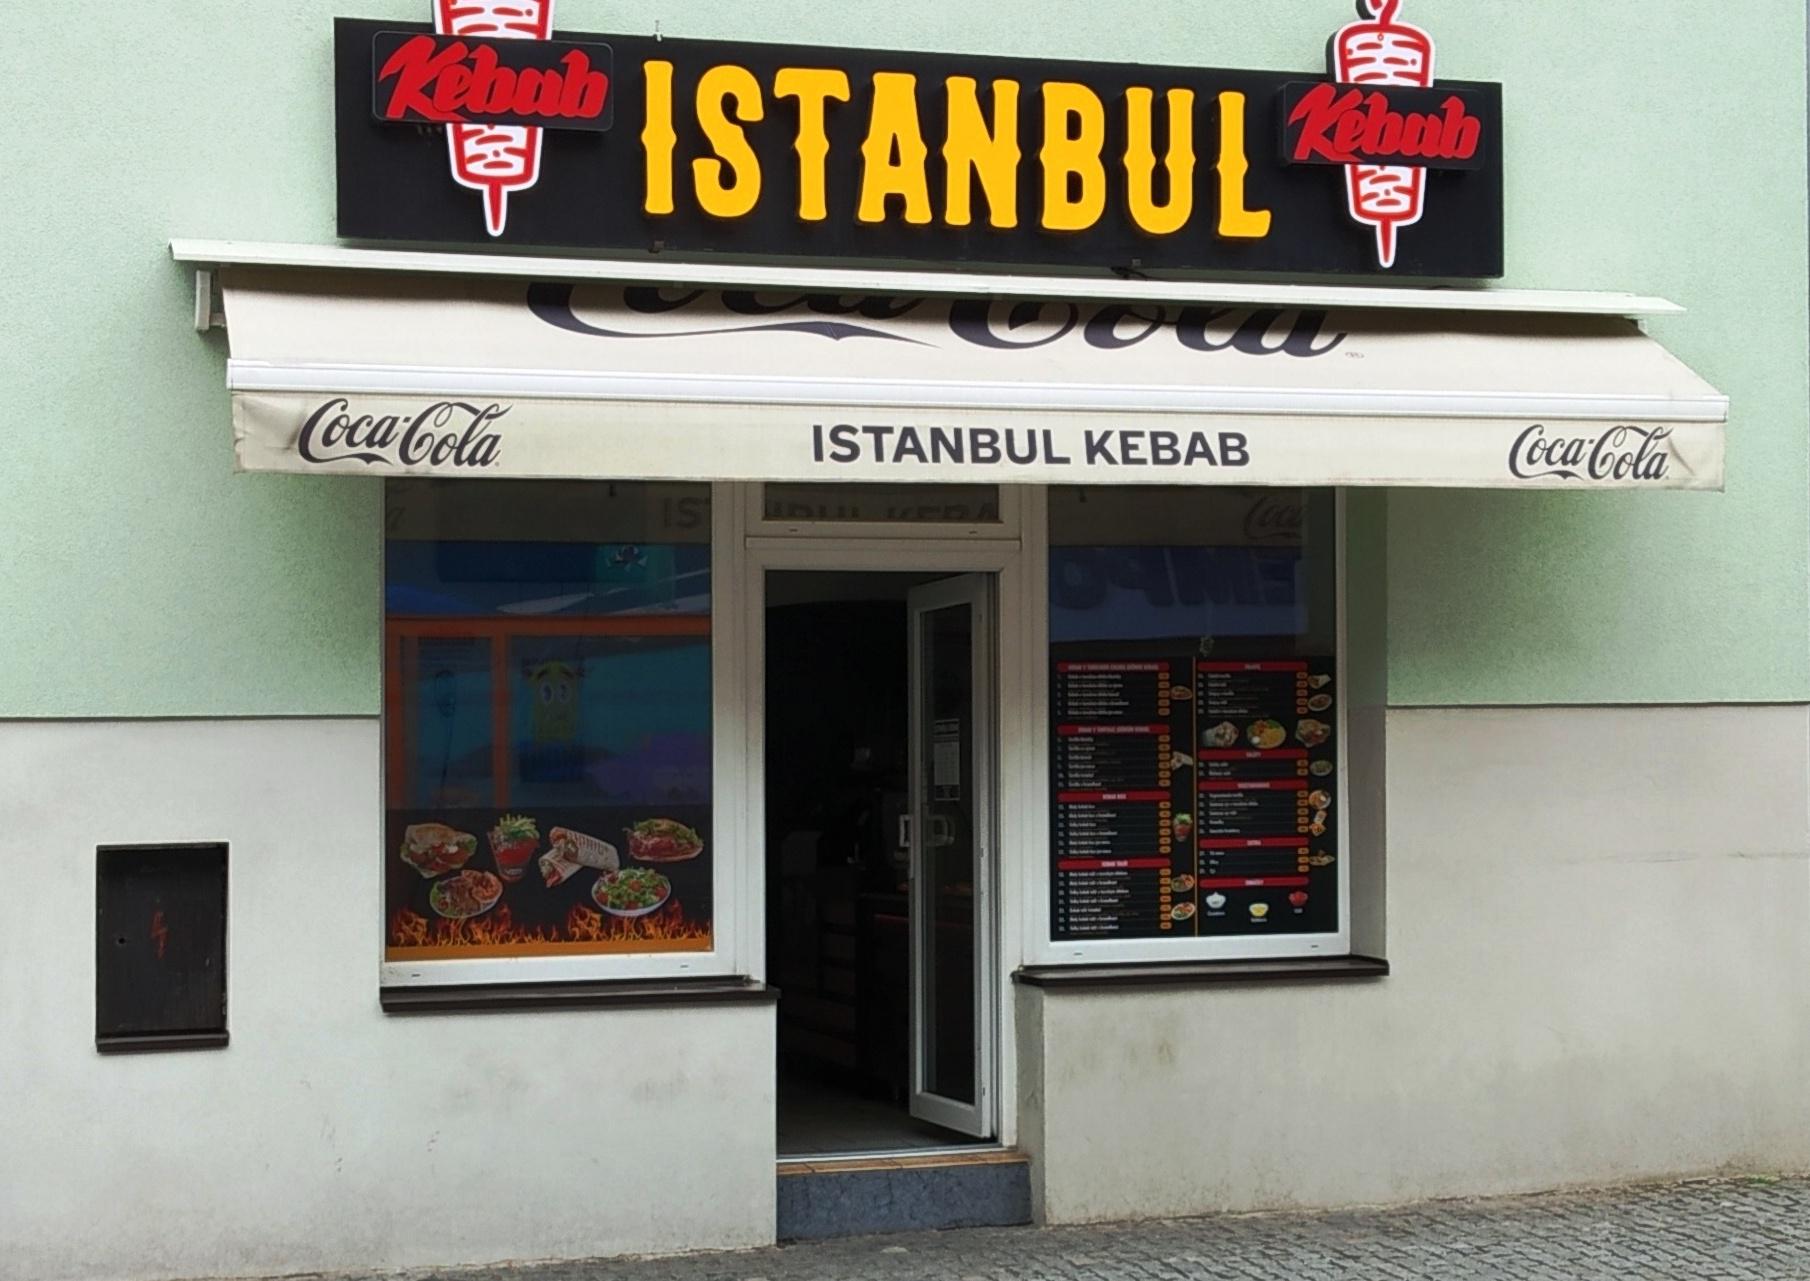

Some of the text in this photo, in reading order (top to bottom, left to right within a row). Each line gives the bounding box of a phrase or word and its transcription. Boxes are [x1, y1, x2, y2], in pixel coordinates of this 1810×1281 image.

[378, 35, 610, 122] Kebab
[641, 60, 1272, 238] ISTANBUL
[1287, 81, 1482, 162] Kebab
[299, 398, 512, 467] Coca-Cola
[812, 424, 1250, 467] ISTANBUL KEBAB
[1509, 424, 1674, 480] Coca-Cola
